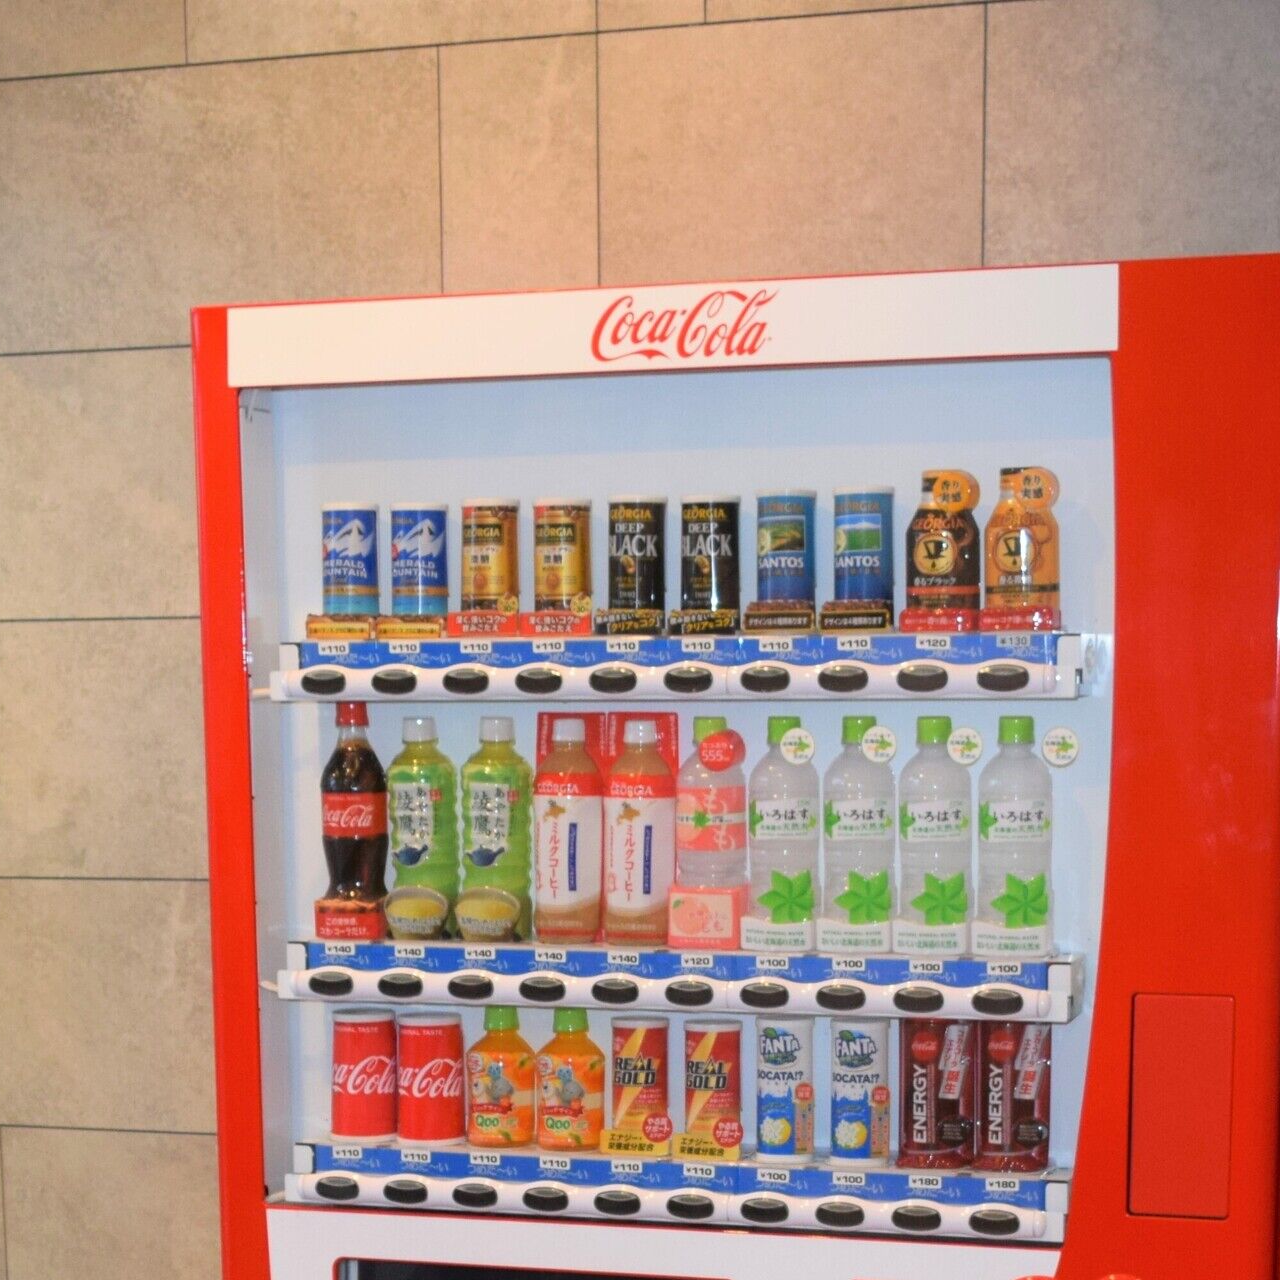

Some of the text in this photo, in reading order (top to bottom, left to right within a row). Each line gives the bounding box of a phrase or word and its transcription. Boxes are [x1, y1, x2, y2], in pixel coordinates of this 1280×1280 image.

[615, 522, 645, 533] DEEP
[688, 522, 719, 533] DEEP
[615, 1053, 655, 1071] REAL
[687, 1056, 726, 1075] REAL
[614, 1070, 656, 1087] GOLD
[686, 1074, 727, 1091] GOLD
[913, 1064, 927, 1144] ENERGY
[988, 1064, 1003, 1145] ENERGY
[476, 1115, 500, 1128] Qoo
[545, 1117, 571, 1130] Qoo
